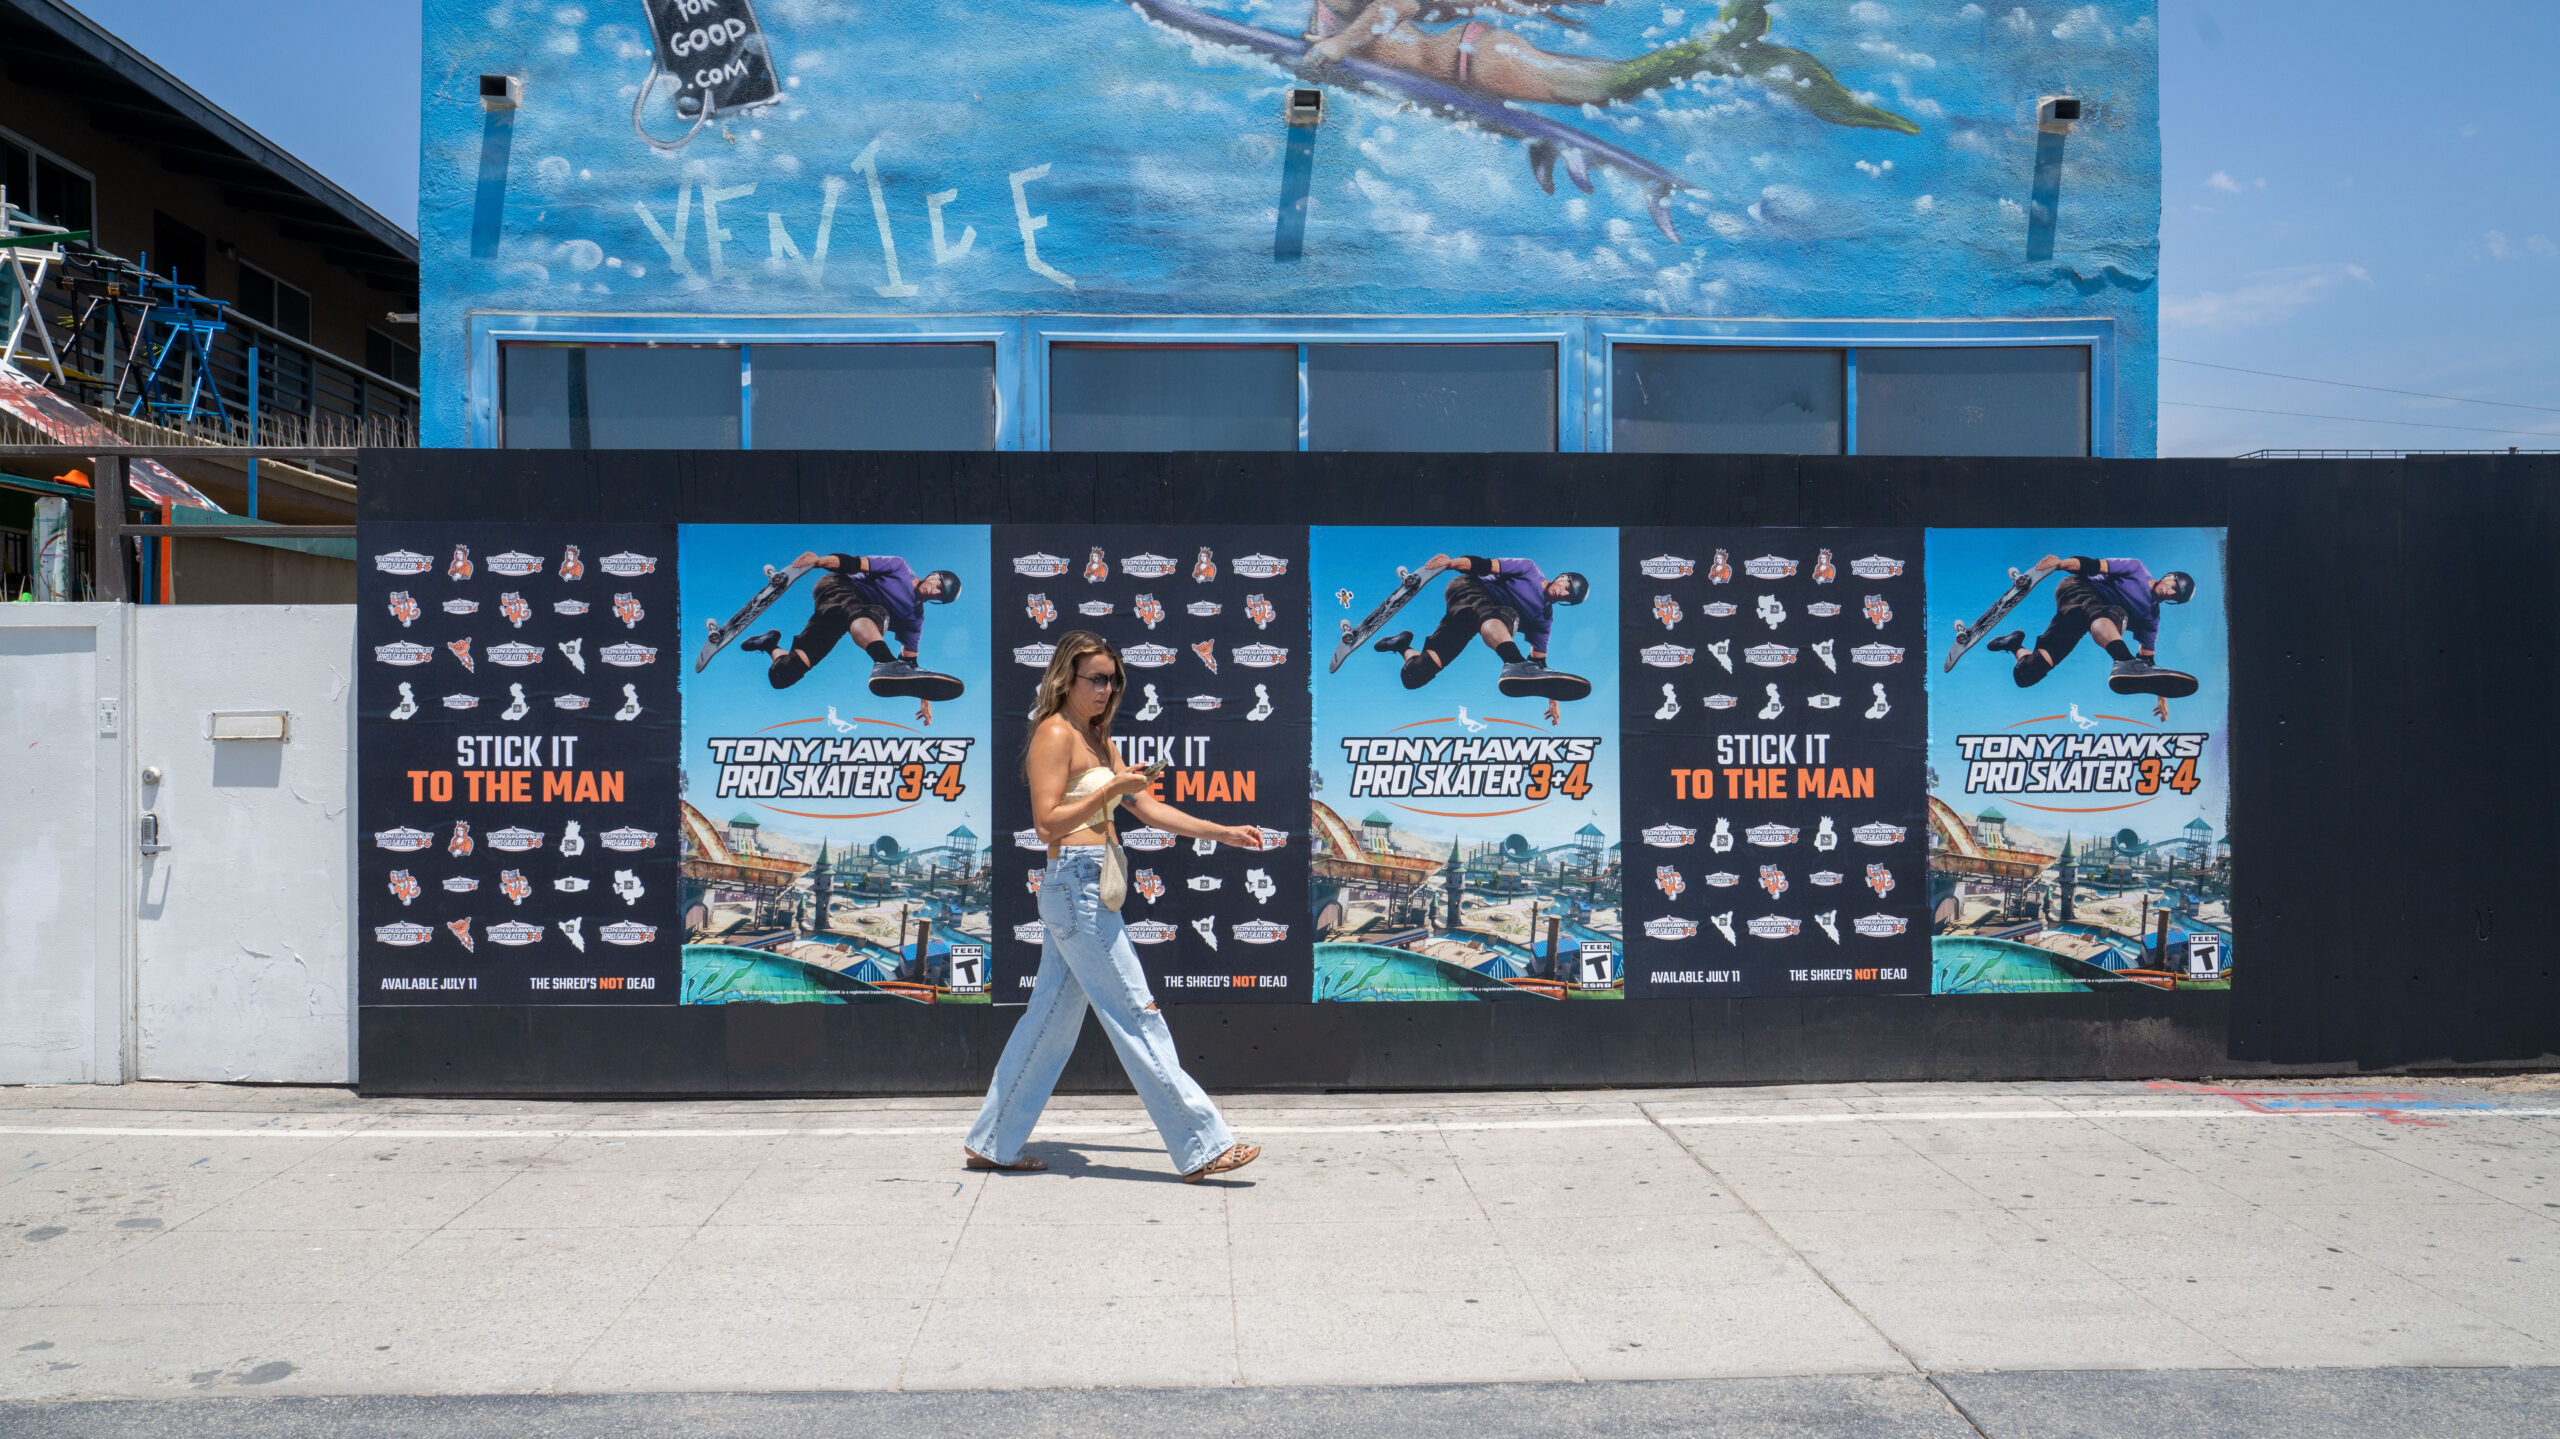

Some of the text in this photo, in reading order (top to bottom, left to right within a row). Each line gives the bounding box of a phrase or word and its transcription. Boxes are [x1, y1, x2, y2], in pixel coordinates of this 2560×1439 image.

[671, 18, 746, 57] GOOD
[457, 735, 579, 767] STICK IT
[710, 739, 824, 762] TONY
[1111, 735, 1211, 767] TICK IT
[1343, 739, 1455, 761] TONY
[1717, 733, 1830, 765] STICK IT
[1958, 737, 2066, 758] TONY
[407, 770, 625, 802] TO THE MAN
[718, 764, 963, 800] PRO SKATER 3+4
[1176, 770, 1256, 802] MAN
[1352, 763, 1591, 799] PRO SKATER 3+4
[1671, 767, 1875, 799] TO THE MAN
[1967, 759, 2199, 794] PRO SKATER 3+4
[955, 957, 979, 984] T
[1585, 954, 1608, 981] T
[2193, 945, 2216, 972] T
[381, 977, 478, 990] AVAILABLE JULY 11
[530, 977, 656, 990] THE SHRED'S NOT DEAD
[1164, 975, 1288, 988] THE SHRED'S NOT DEAD
[1650, 970, 1741, 984] AVAILABLE JULY 11
[1789, 967, 1908, 982] THE SHRED'S NOT DEAD
